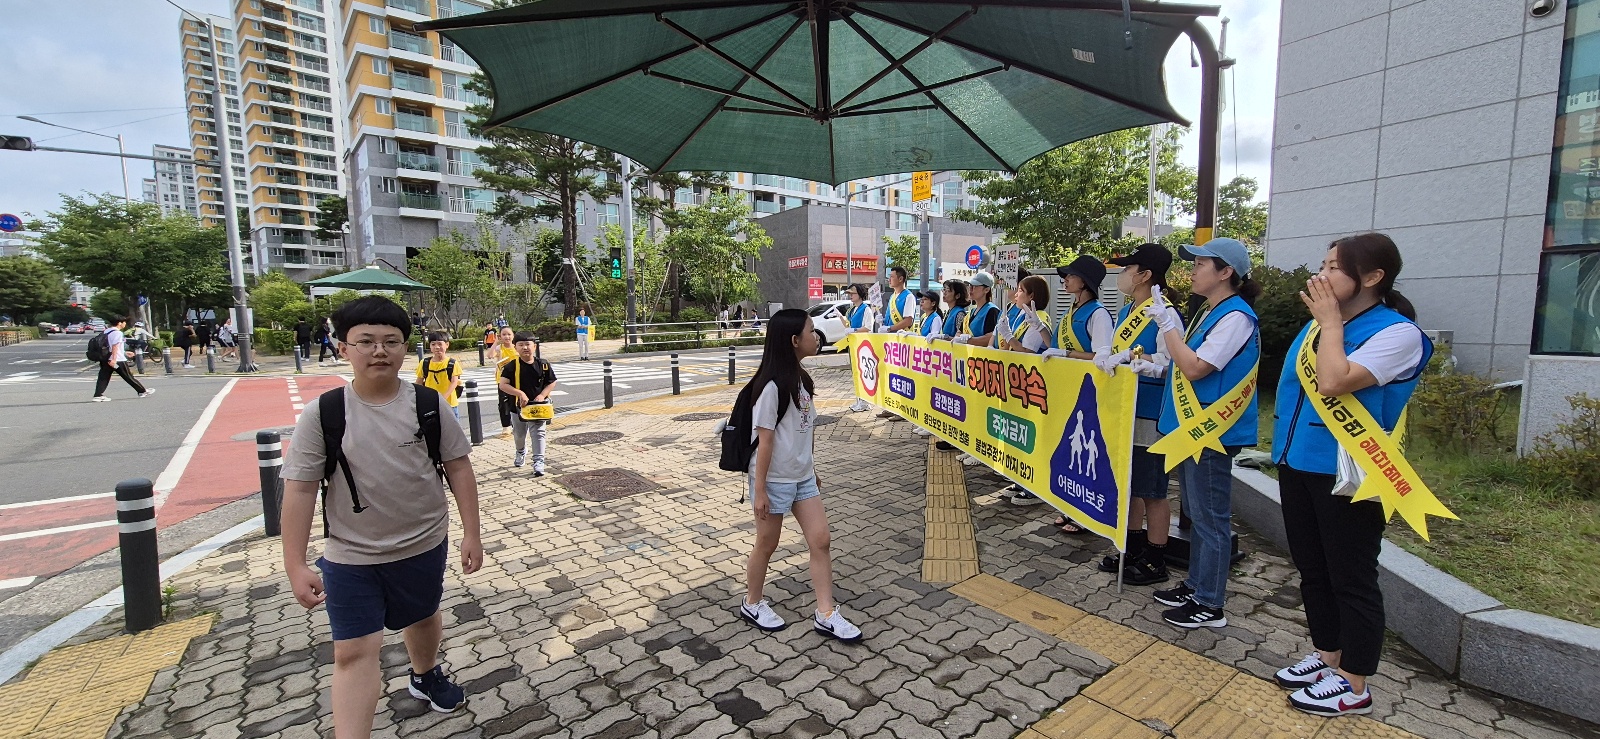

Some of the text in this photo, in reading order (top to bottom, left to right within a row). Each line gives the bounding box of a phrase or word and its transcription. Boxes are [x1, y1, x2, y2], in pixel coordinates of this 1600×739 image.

[862, 355, 876, 381] 30
[883, 342, 1048, 415] 어린이 보호구역 내 3가지 약속
[891, 377, 912, 396] 속도제한
[934, 392, 961, 417] 잠깐멈춤
[959, 429, 970, 447] 멈춤
[992, 413, 1028, 447] 주차금지
[1188, 417, 1219, 441] 제로
[975, 437, 1034, 484] 불법주정차 하지 않기
[1320, 395, 1367, 438] 보이면
[1359, 436, 1413, 498] 일단멈춤
[1058, 474, 1106, 513] 어린이보호
